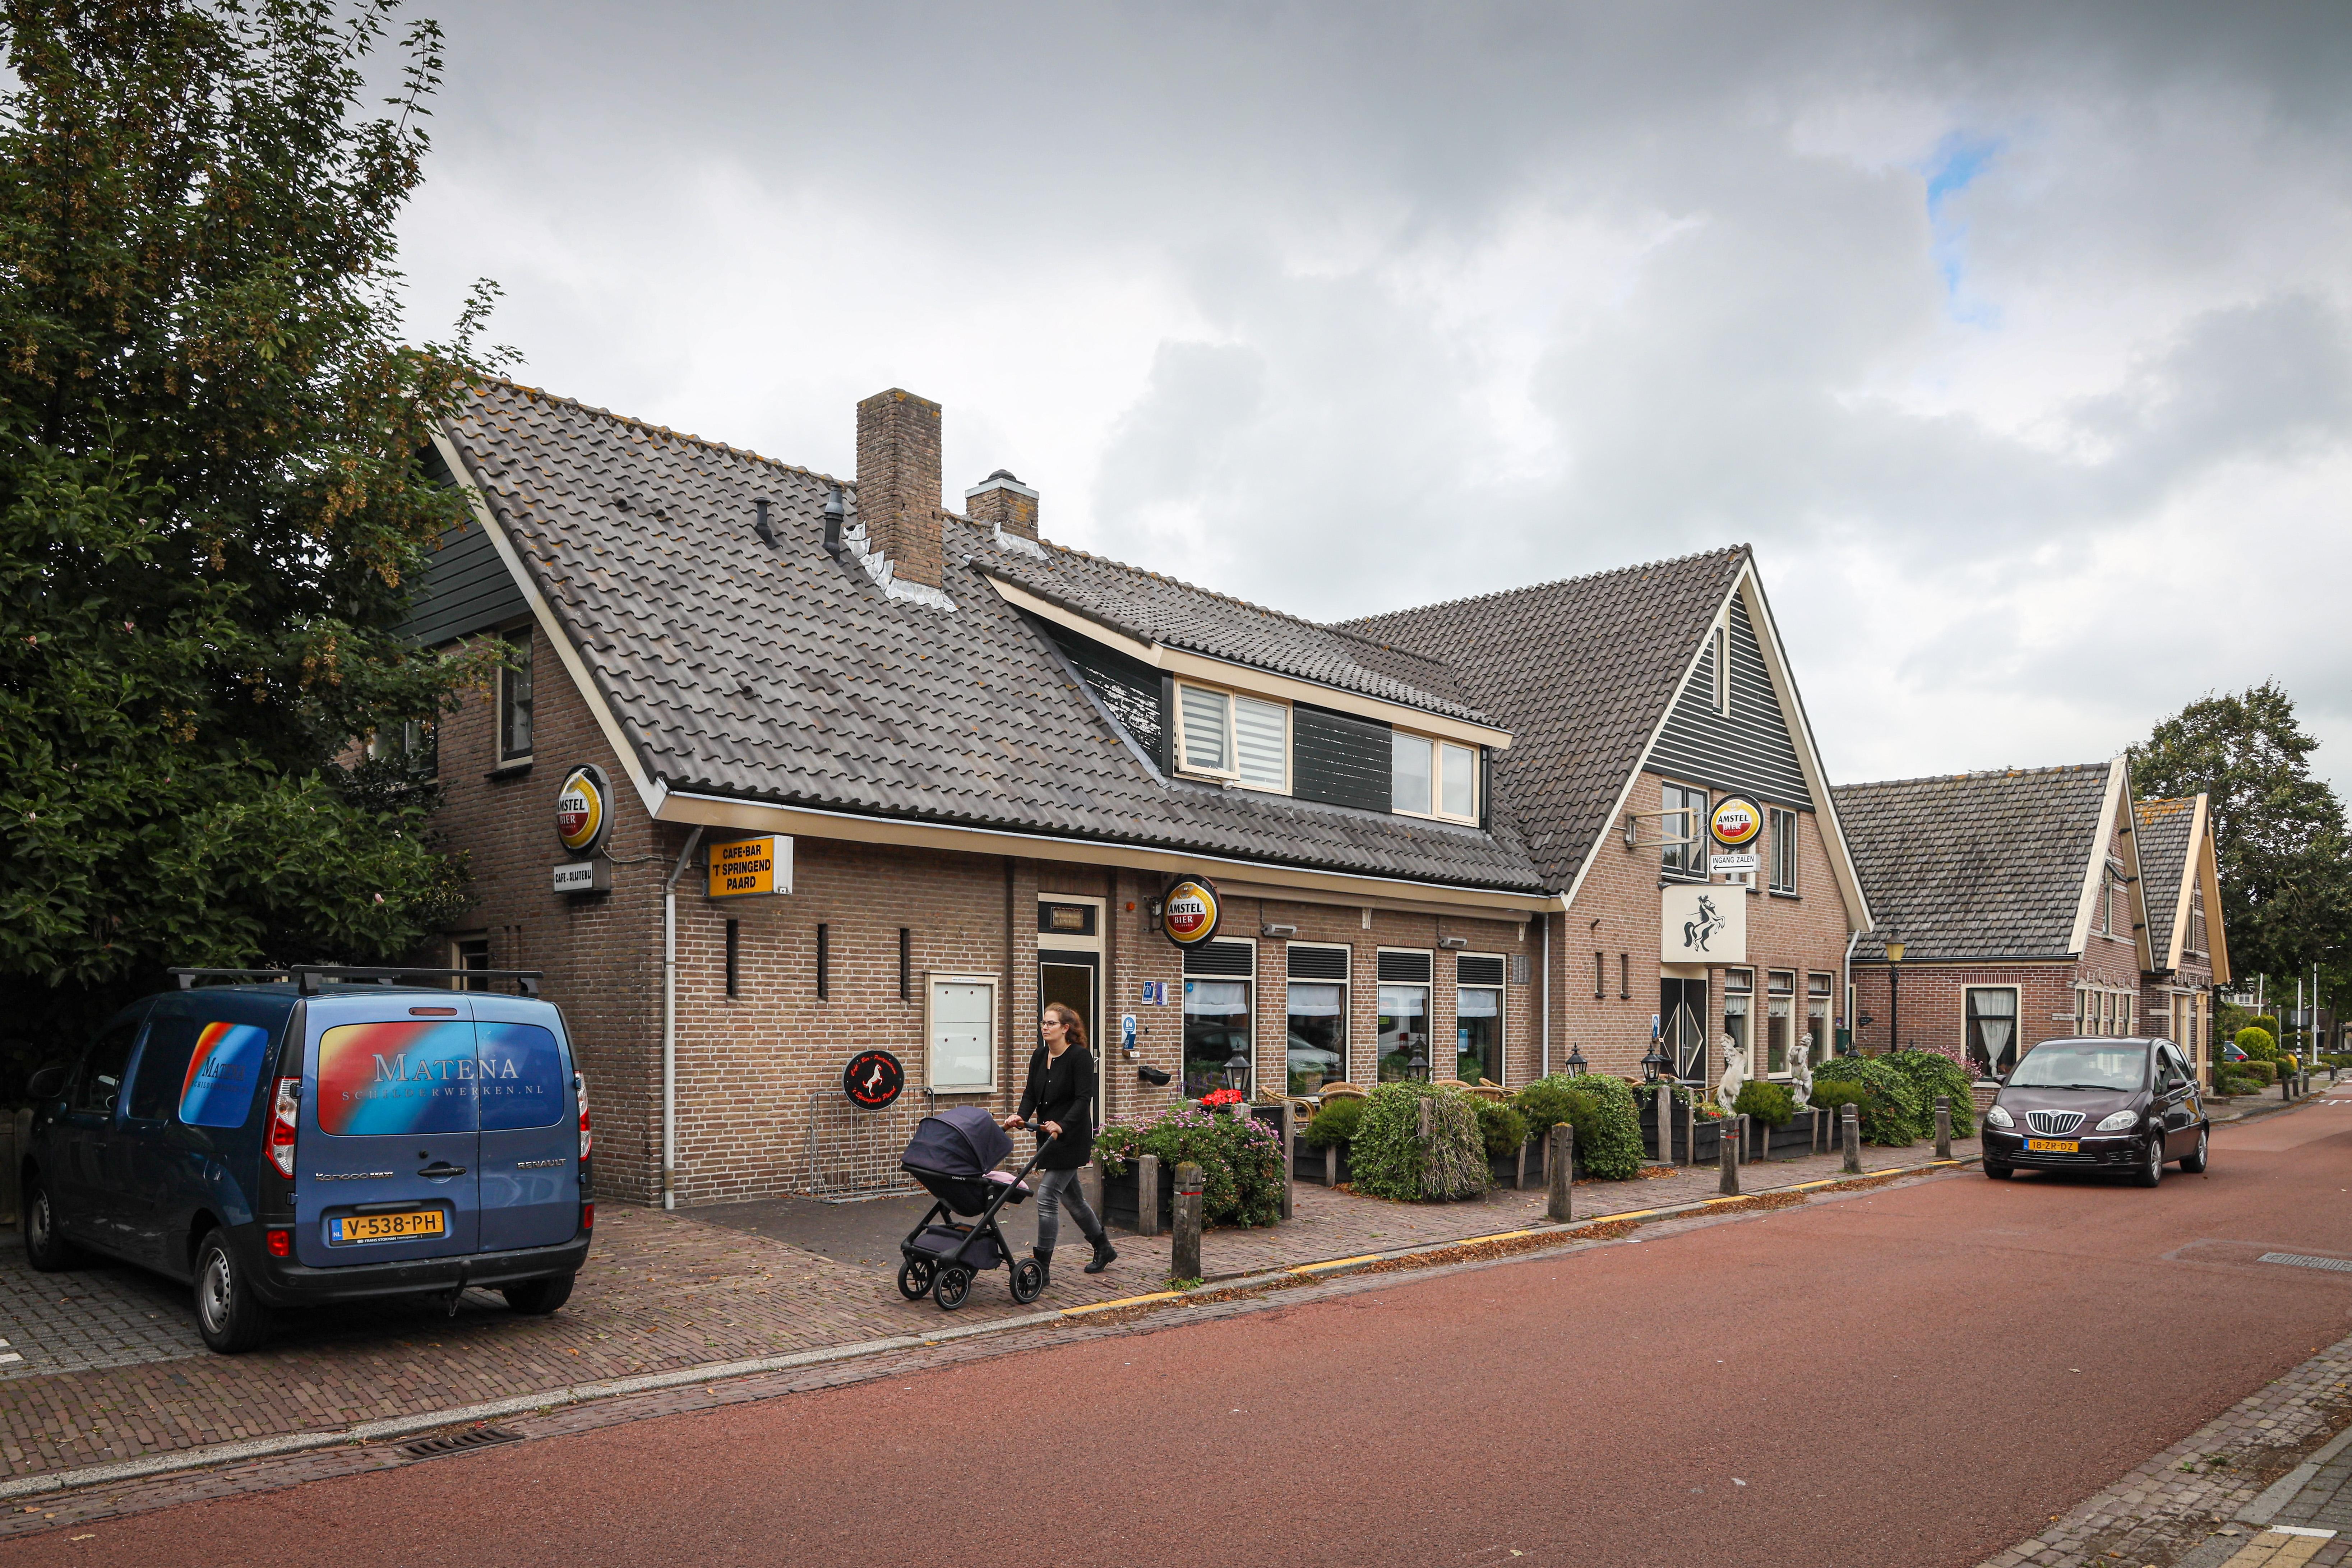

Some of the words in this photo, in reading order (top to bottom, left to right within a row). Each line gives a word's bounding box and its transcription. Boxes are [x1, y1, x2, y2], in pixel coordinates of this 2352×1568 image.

[560, 815, 576, 824] BIER
[1718, 814, 1748, 823] AMSTEL
[723, 845, 761, 860] CAFE-BAR
[713, 864, 720, 876] 'T
[722, 859, 771, 876] SPRINGEND
[727, 876, 756, 890] PAARD
[1169, 903, 1202, 914] AMSTEL
[342, 1086, 543, 1101] SCHILDERWERKEN.NL
[2033, 1141, 2073, 1150] 18-ZR-DZ
[517, 1158, 566, 1170] RENAULT
[348, 1215, 436, 1236] V-538-PH
